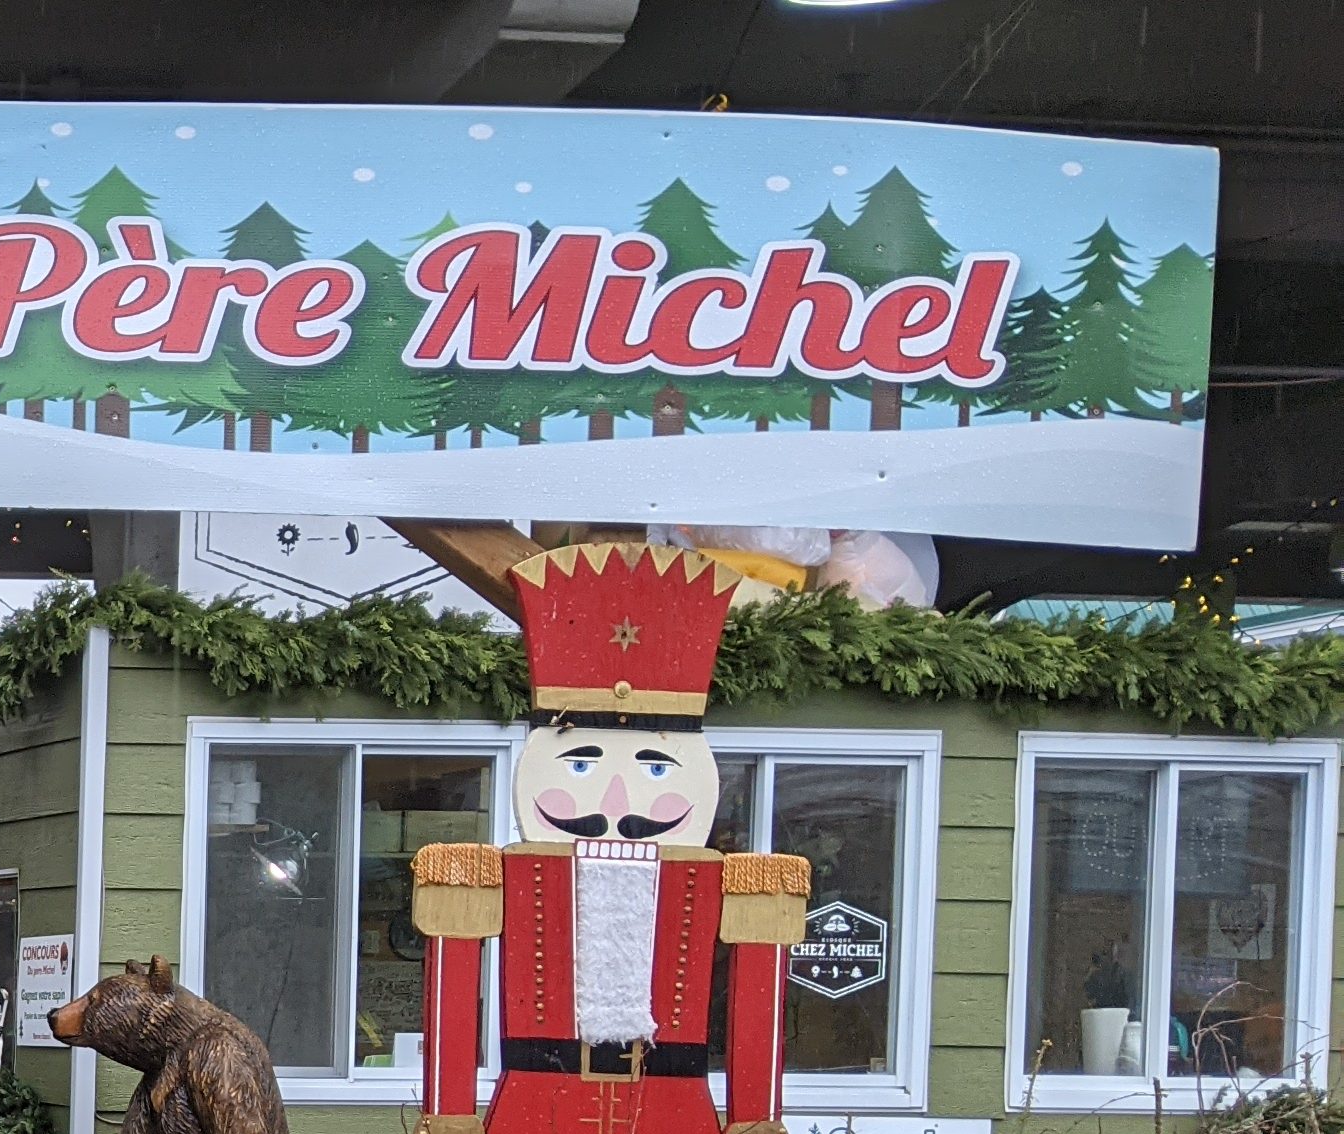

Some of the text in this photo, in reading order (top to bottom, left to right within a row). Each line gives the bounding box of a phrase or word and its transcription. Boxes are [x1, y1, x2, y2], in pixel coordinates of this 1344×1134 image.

[406, 224, 1017, 385] Michel
[23, 945, 60, 961] CONCOURS
[790, 943, 882, 957] CHEZ MICHEL
